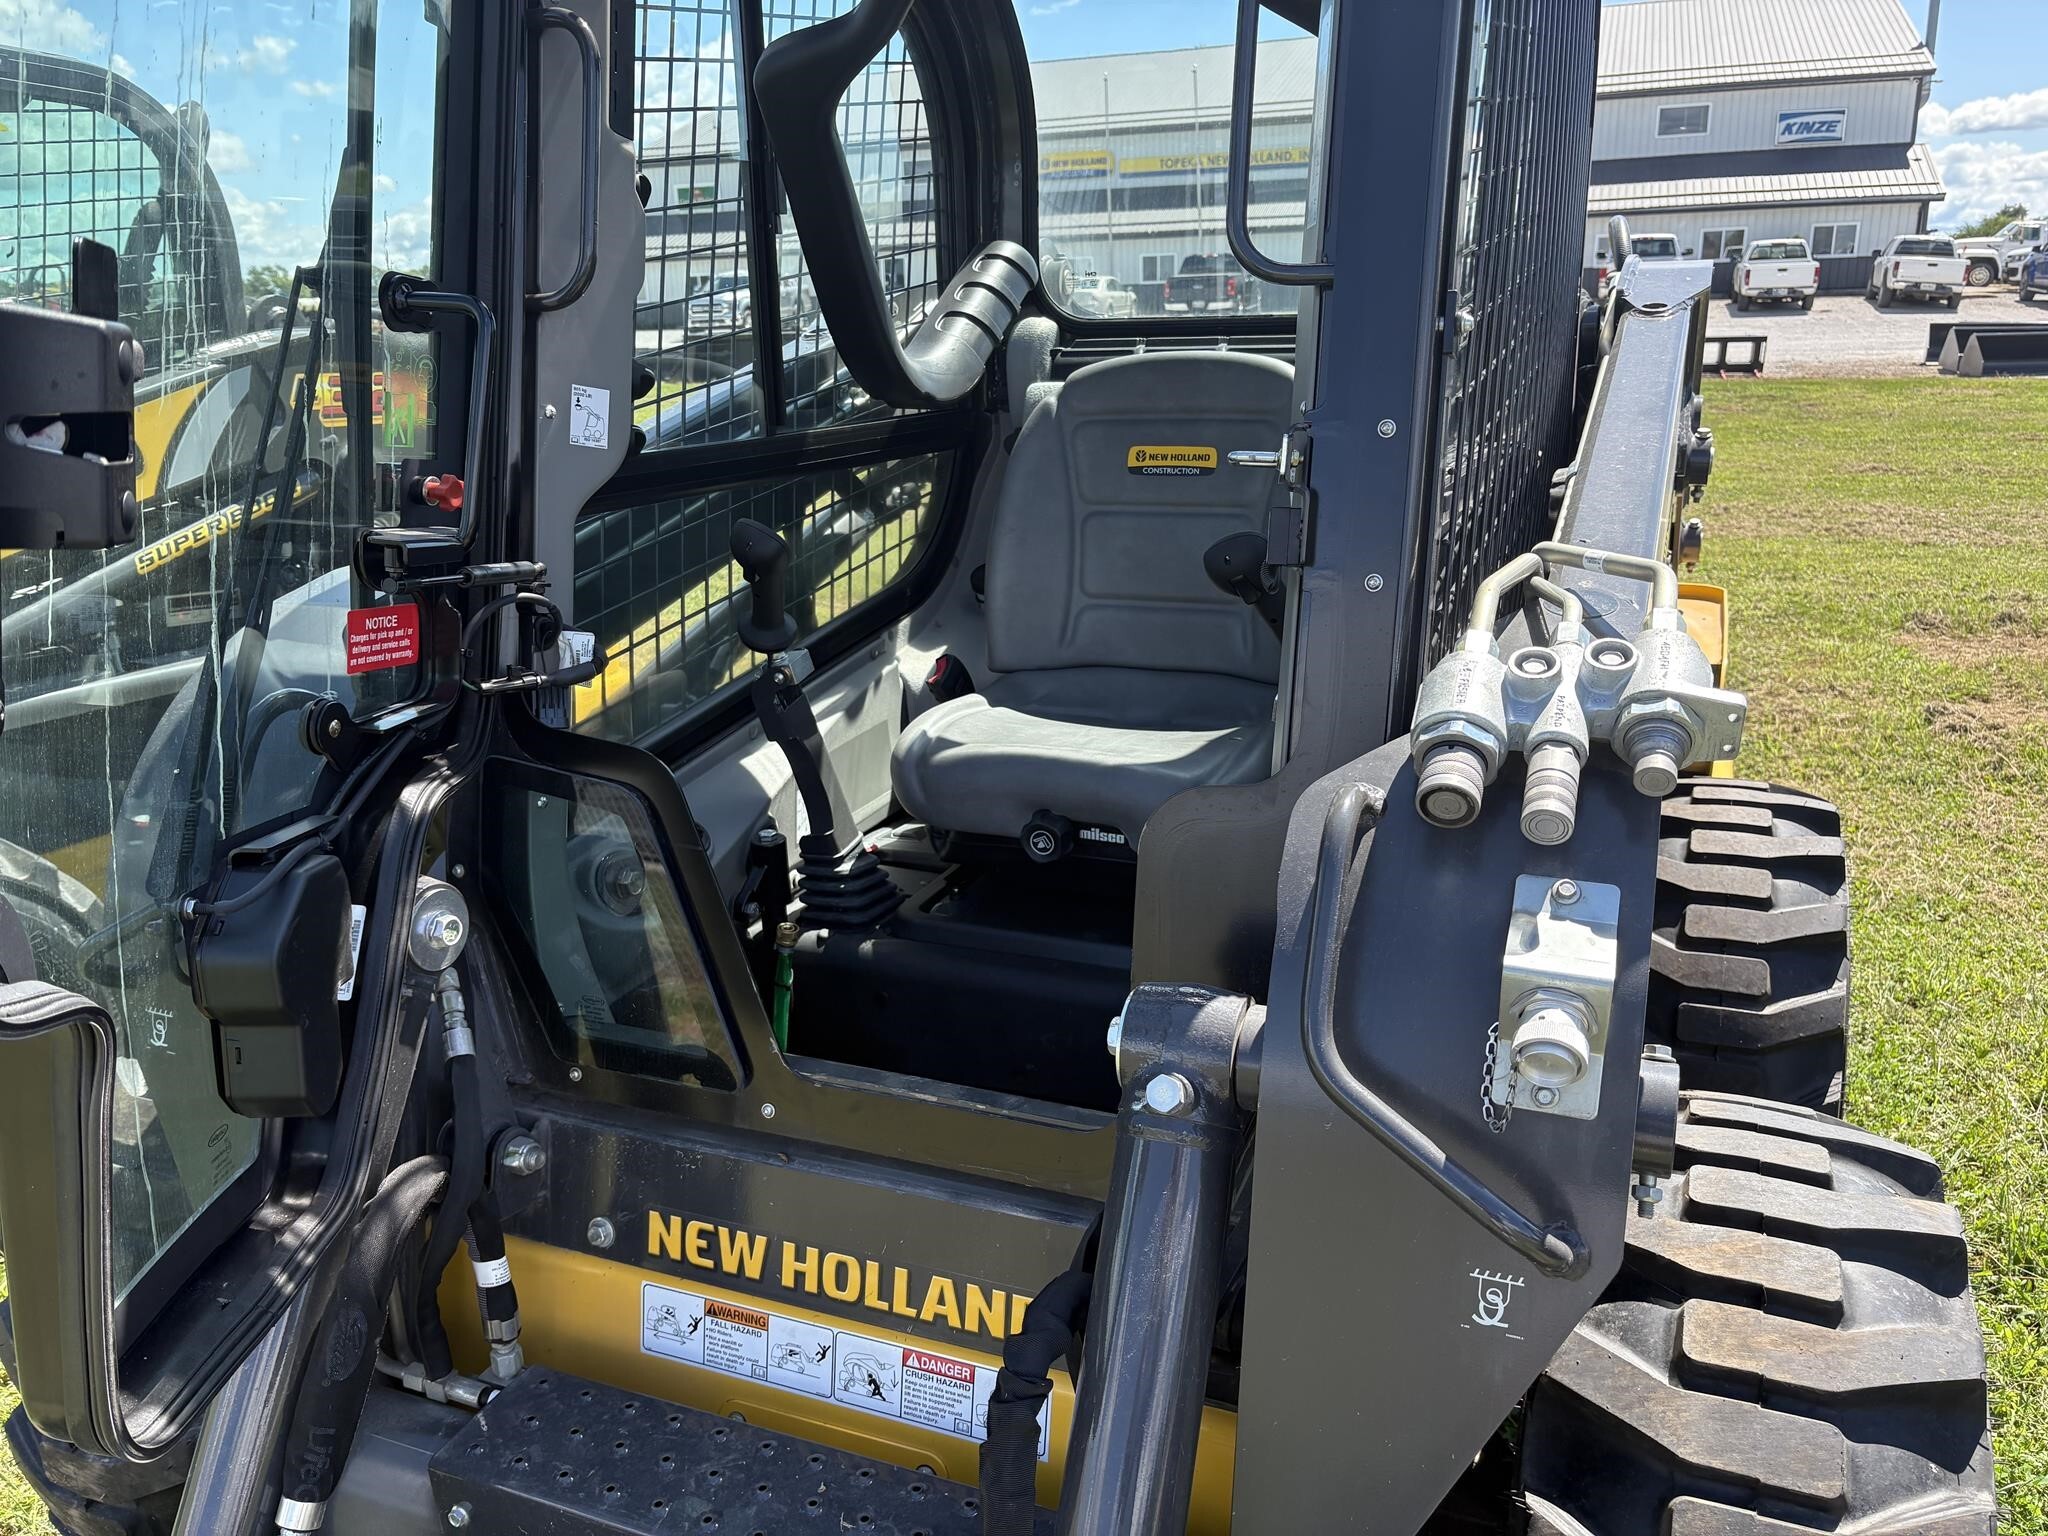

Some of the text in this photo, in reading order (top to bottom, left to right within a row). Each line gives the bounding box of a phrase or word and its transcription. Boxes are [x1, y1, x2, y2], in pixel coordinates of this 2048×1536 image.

[1781, 120, 1841, 136] KINZE
[1149, 453, 1210, 462] NEW HOLLAND
[1142, 467, 1200, 475] CONSTRUCTION
[366, 615, 398, 630] NOTICE
[350, 634, 370, 643] Charges
[377, 631, 387, 641] pick
[395, 628, 404, 637] and
[352, 638, 410, 654] delivery and service calls
[357, 656, 366, 664] not
[366, 653, 385, 663] covered
[385, 652, 391, 661] by
[392, 649, 414, 659] warranty.
[1080, 828, 1125, 844] milsco
[648, 1210, 769, 1281] NEW
[717, 1305, 766, 1327] WARNING
[711, 1319, 762, 1338] FALL HAZARD
[706, 1346, 722, 1354] Failure
[728, 1353, 745, 1361] comply
[921, 1357, 971, 1380] DANGER
[905, 1369, 971, 1392] CRUSH HAZARD
[905, 1379, 918, 1387] Keep
[957, 1392, 972, 1400] when
[928, 1391, 944, 1399] raised
[945, 1396, 962, 1404] unless
[928, 1398, 956, 1409] supported.
[903, 1397, 922, 1407] Failure
[928, 1404, 947, 1414] comply
[948, 1409, 963, 1418] could
[903, 1404, 918, 1412] result
[925, 1410, 940, 1418] death
[903, 1411, 938, 1424] serious injury.
